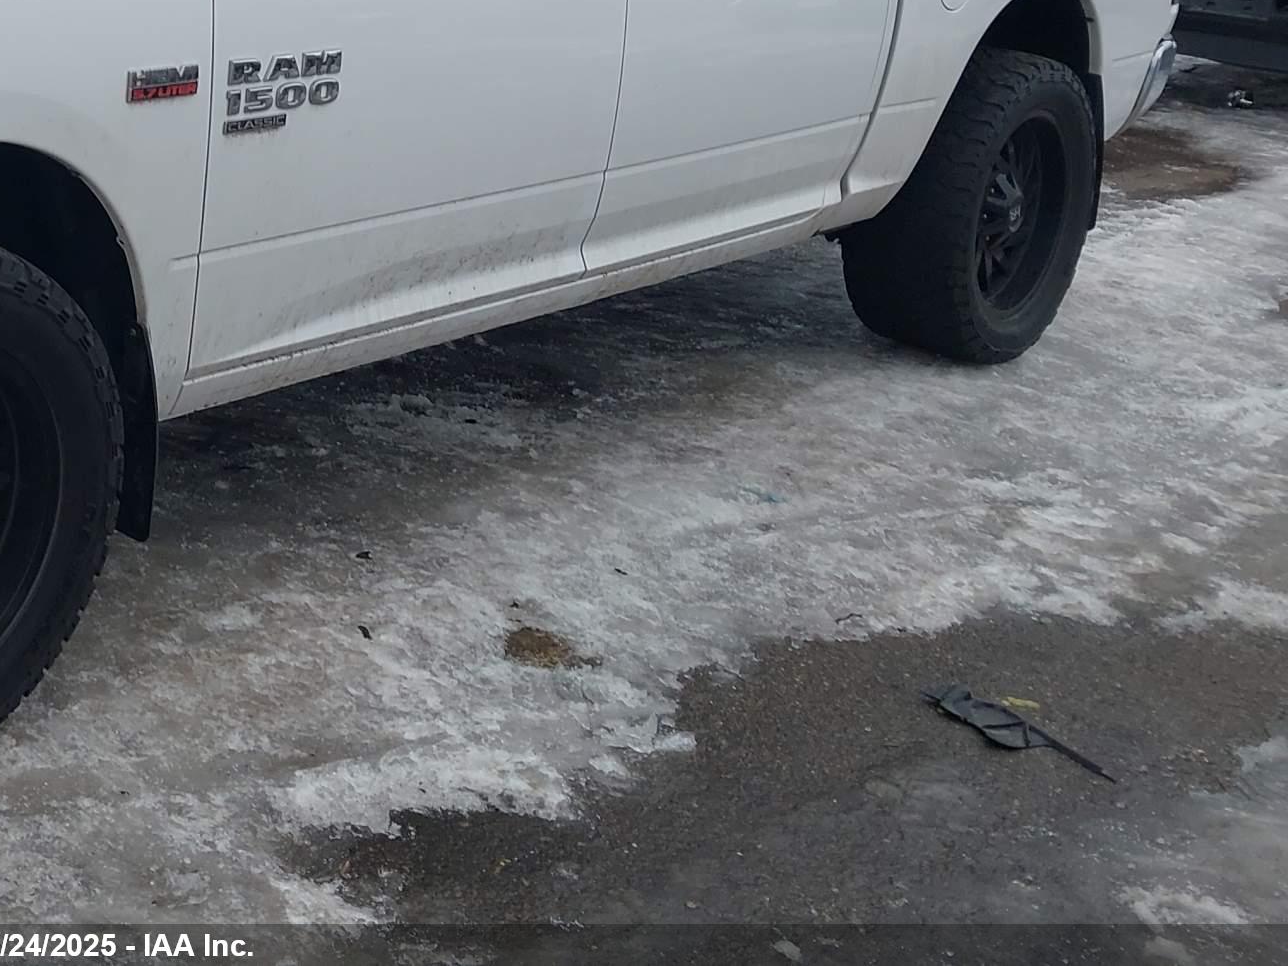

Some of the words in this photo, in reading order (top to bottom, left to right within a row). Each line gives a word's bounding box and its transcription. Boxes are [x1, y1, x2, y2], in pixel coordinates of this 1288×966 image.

[127, 65, 199, 89] HEMI
[227, 50, 343, 86] RAM
[225, 78, 340, 116] 1500
[226, 115, 287, 133] CLASSIC
